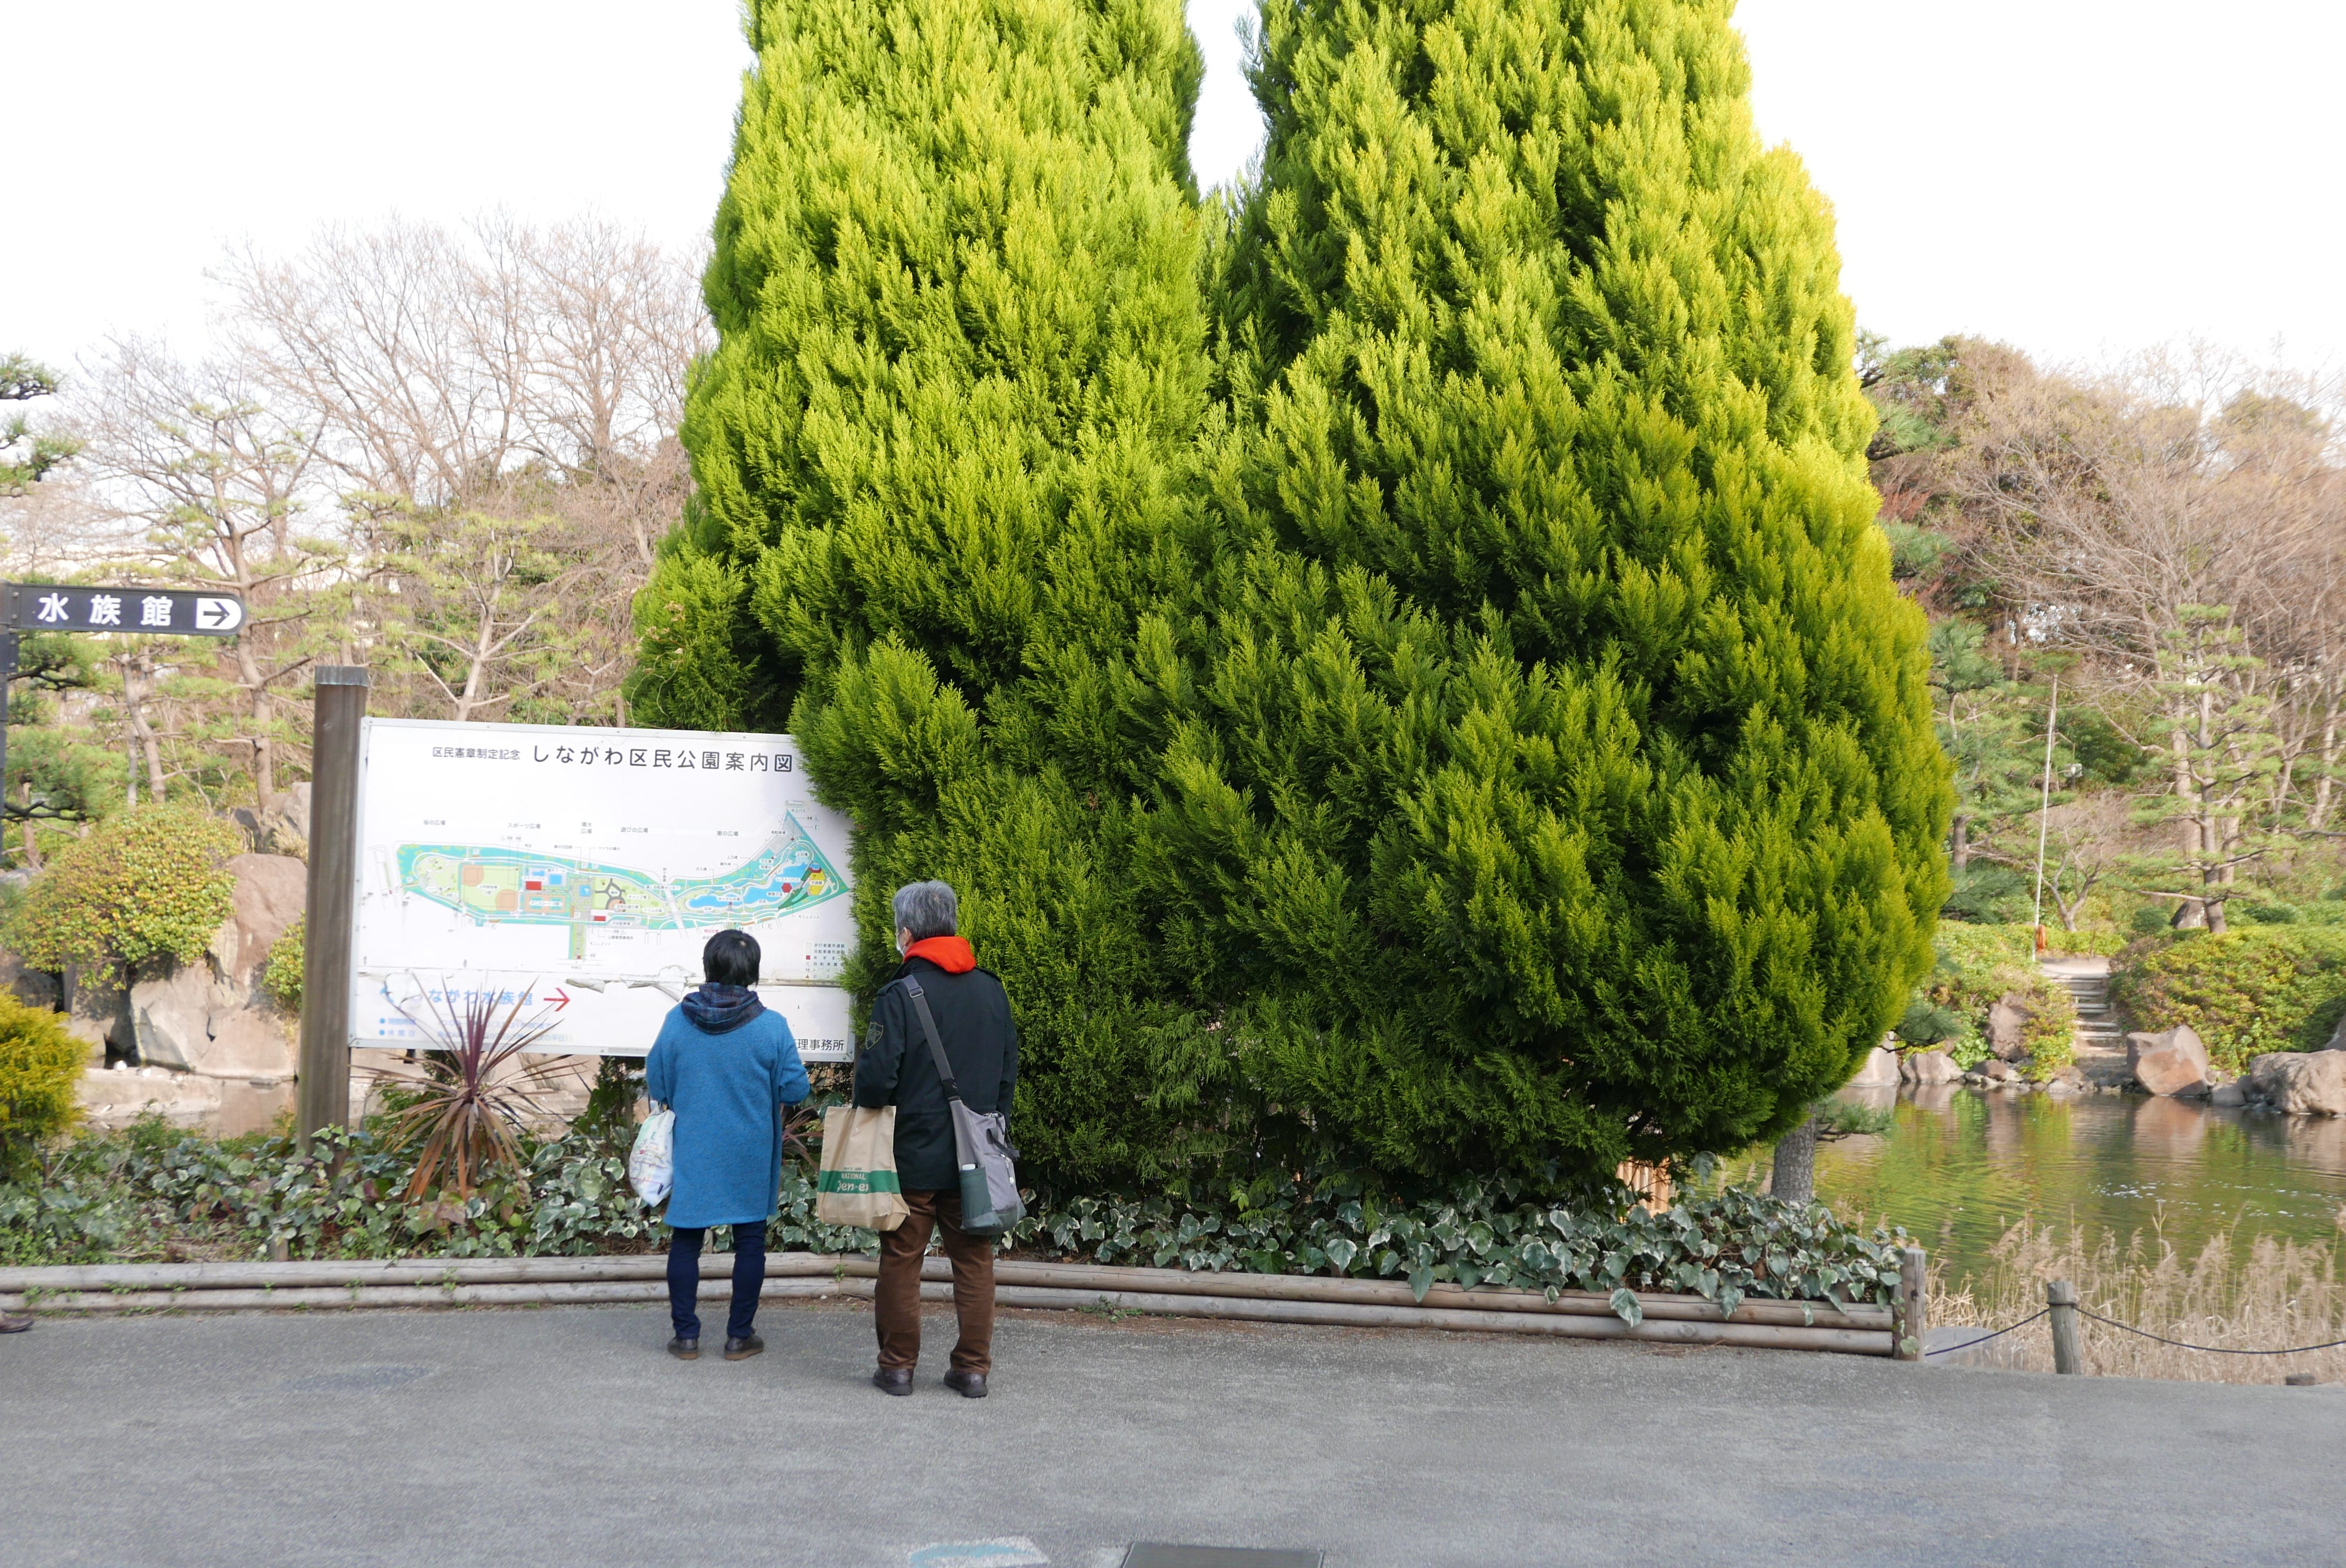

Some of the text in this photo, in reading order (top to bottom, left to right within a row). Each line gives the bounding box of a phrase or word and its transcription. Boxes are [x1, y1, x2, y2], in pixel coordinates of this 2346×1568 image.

[37, 592, 173, 627] 水族館
[432, 744, 793, 772] 区民憲章制定記念 しながわ区民公園案内図
[795, 1038, 844, 1051] 理事務所
